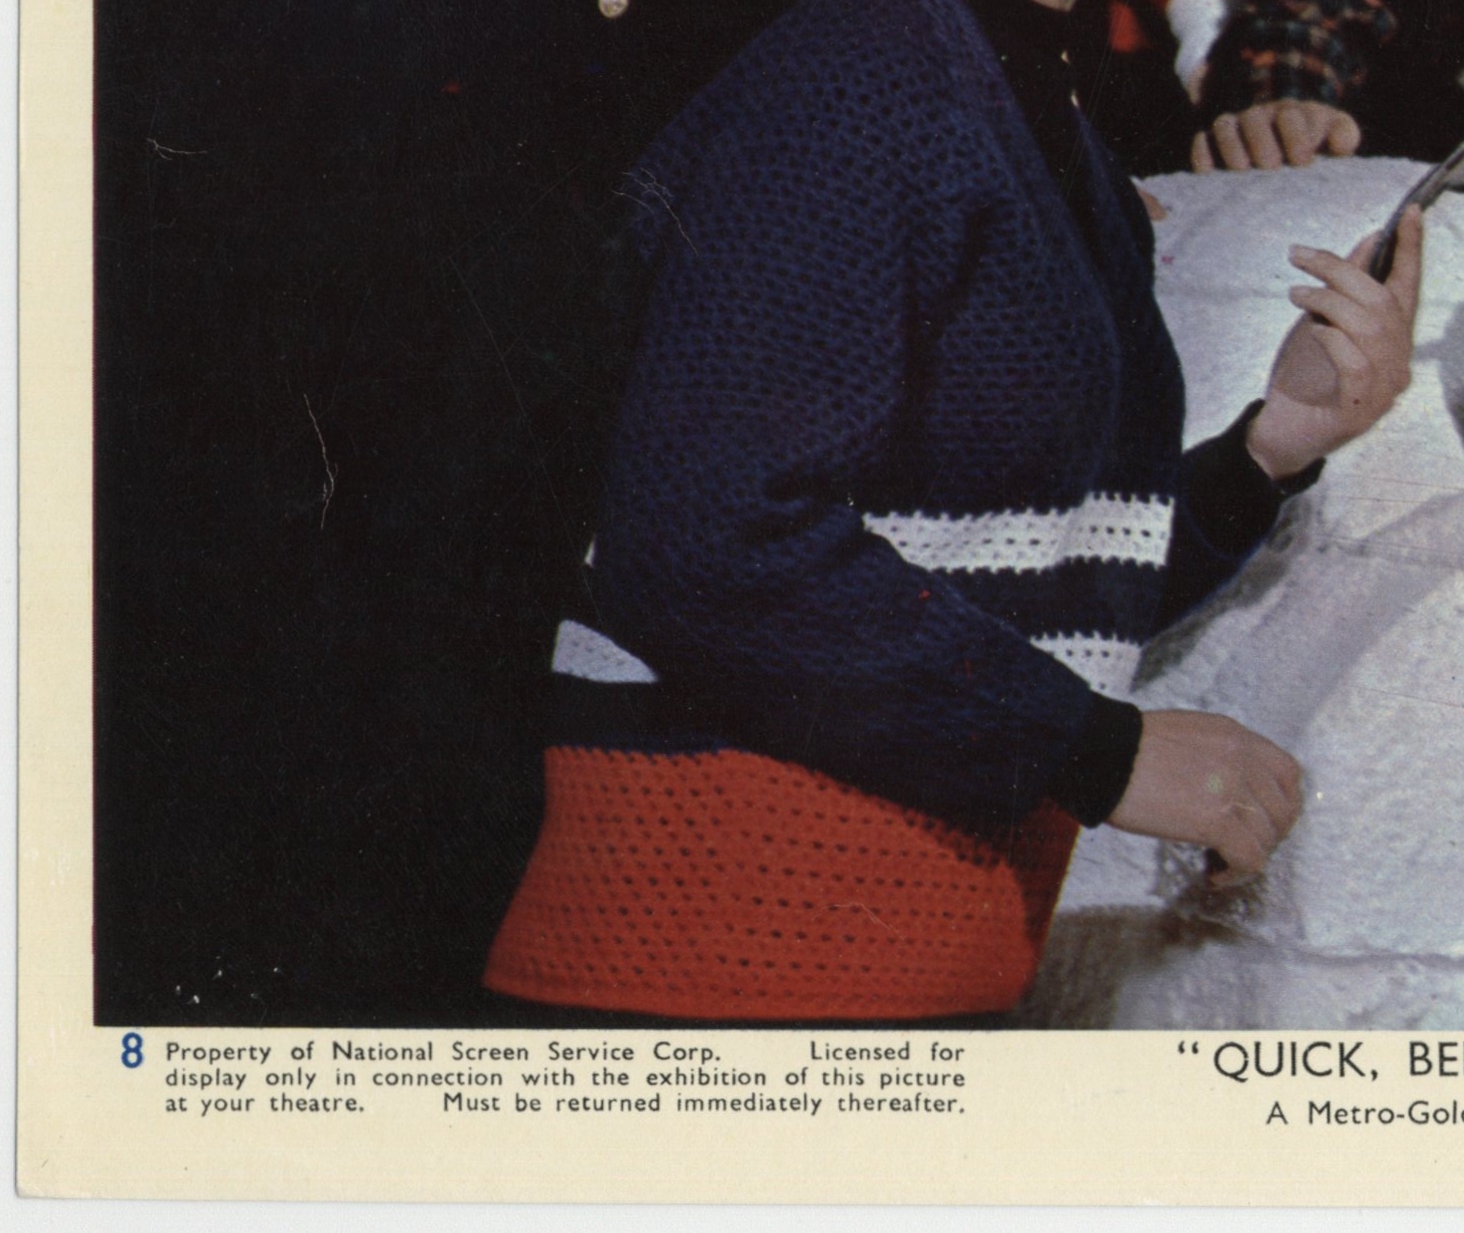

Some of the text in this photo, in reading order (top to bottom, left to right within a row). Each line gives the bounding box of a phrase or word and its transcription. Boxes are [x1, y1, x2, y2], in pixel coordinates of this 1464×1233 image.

[120, 1031, 144, 1069] 8
[166, 1040, 966, 1066] Property of National Screen Service Corp. Licensed for
[165, 1066, 966, 1091] display only in connection with the exhibition of this picture
[165, 1091, 965, 1118] at your theatre. Must be returned immediately thereafter.
[1265, 1100, 1289, 1125] A
